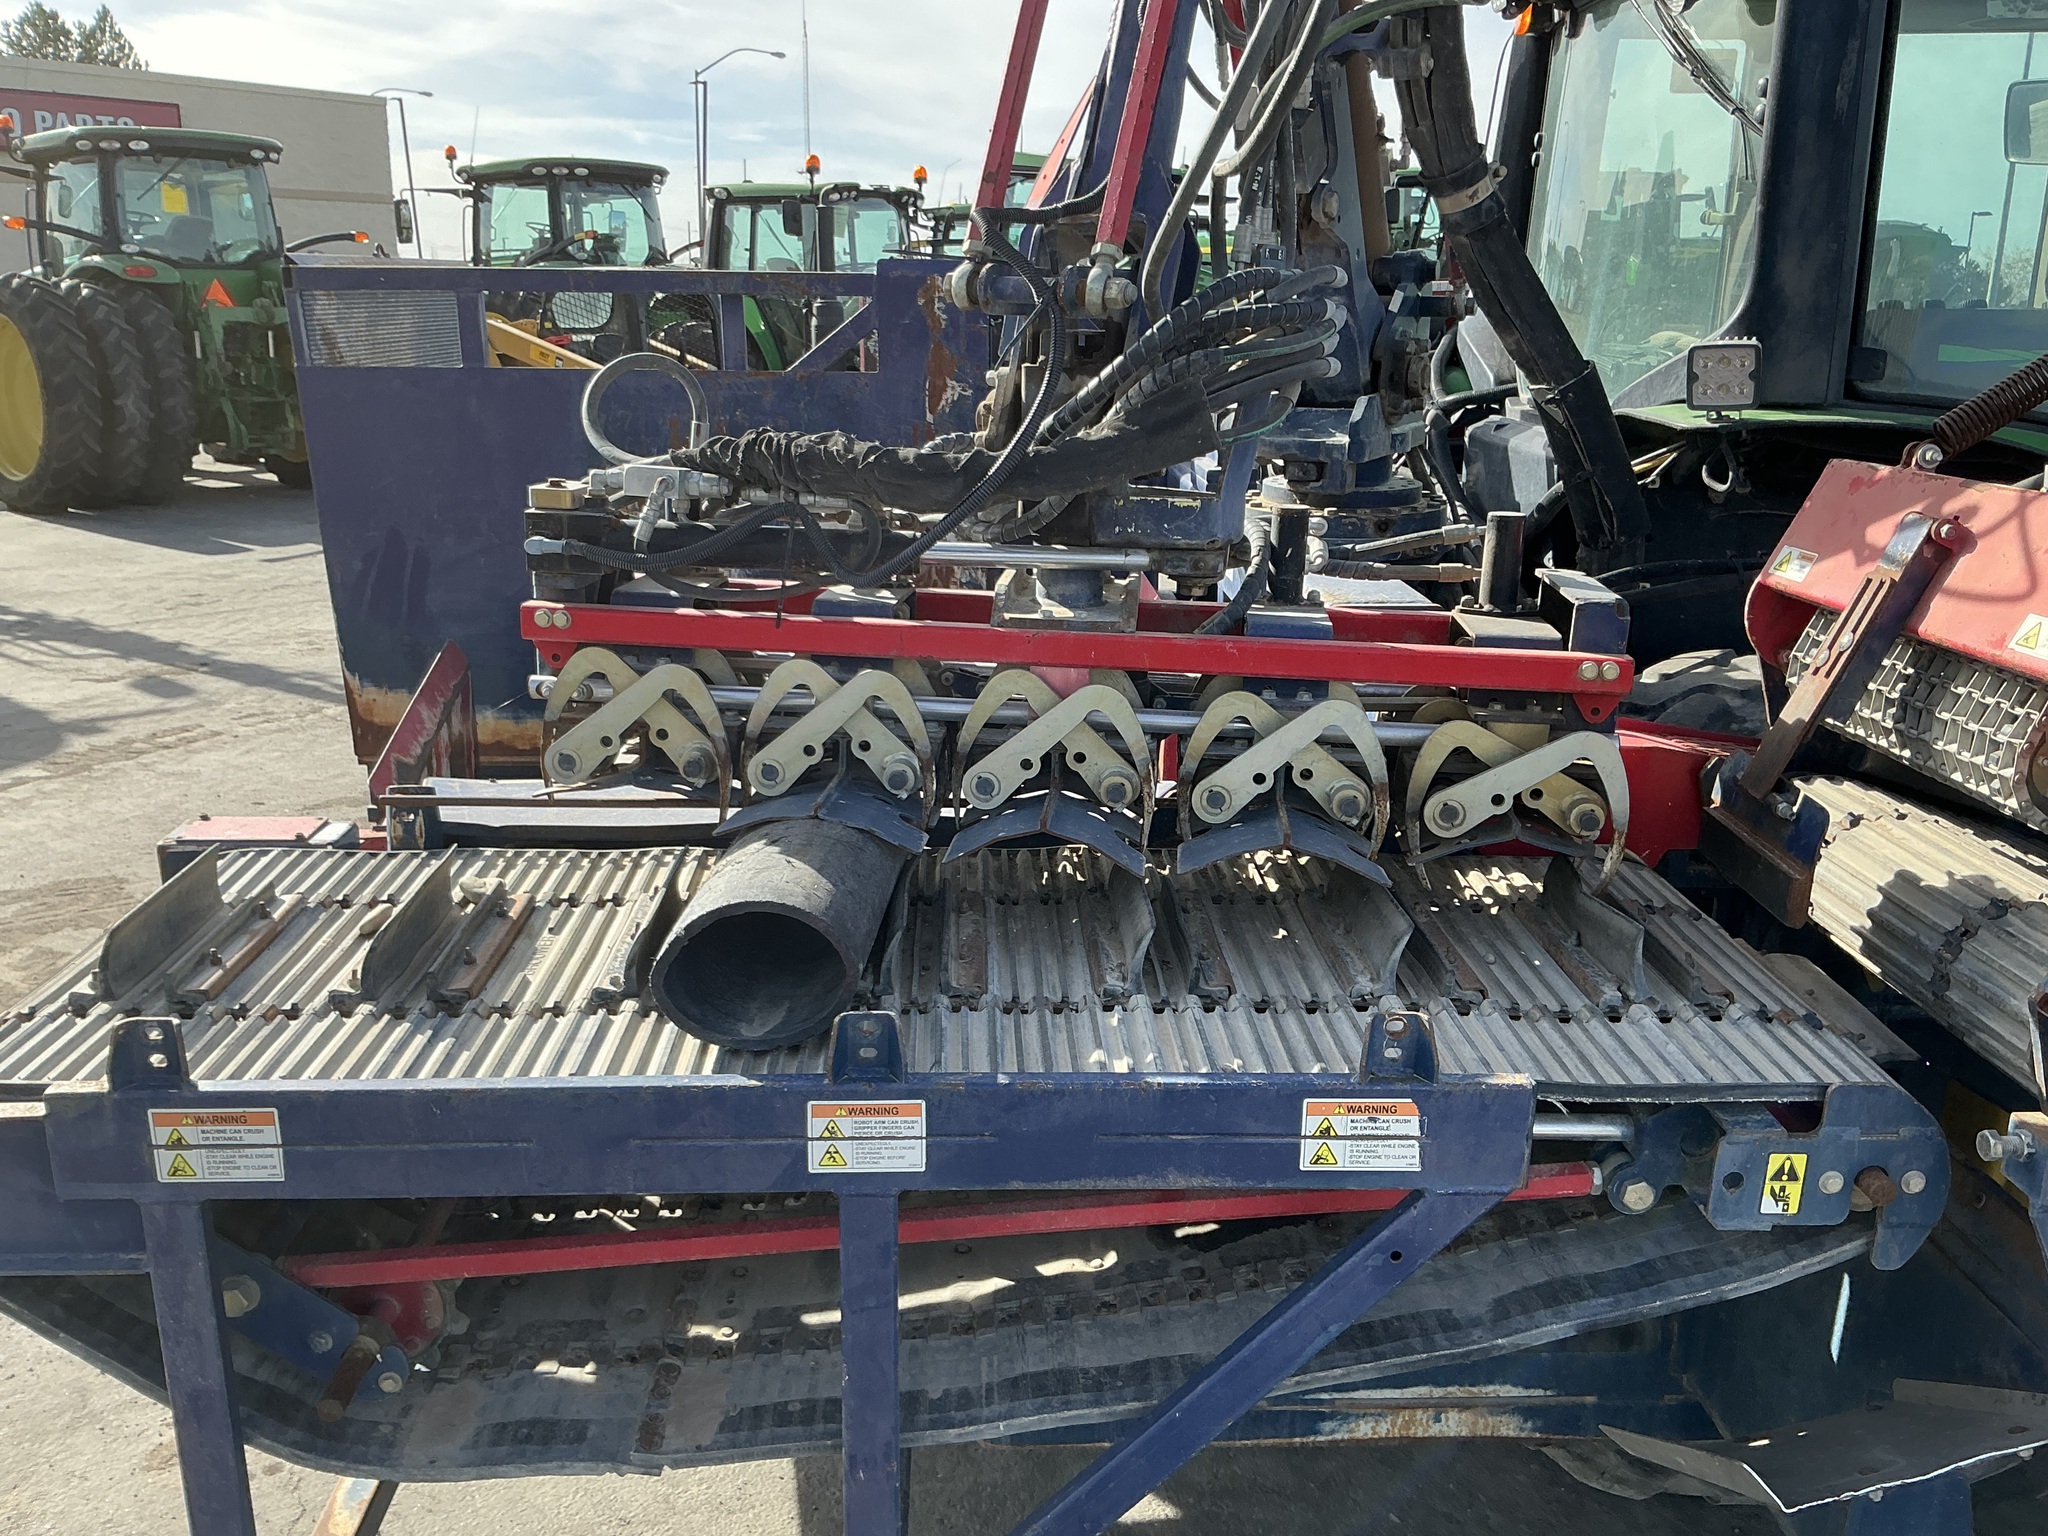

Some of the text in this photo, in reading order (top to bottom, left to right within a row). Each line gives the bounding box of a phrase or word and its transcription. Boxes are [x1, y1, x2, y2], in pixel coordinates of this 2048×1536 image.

[848, 1107, 899, 1116] WARNING
[1346, 1105, 1398, 1114] WARNING
[193, 1115, 248, 1124] WARNING
